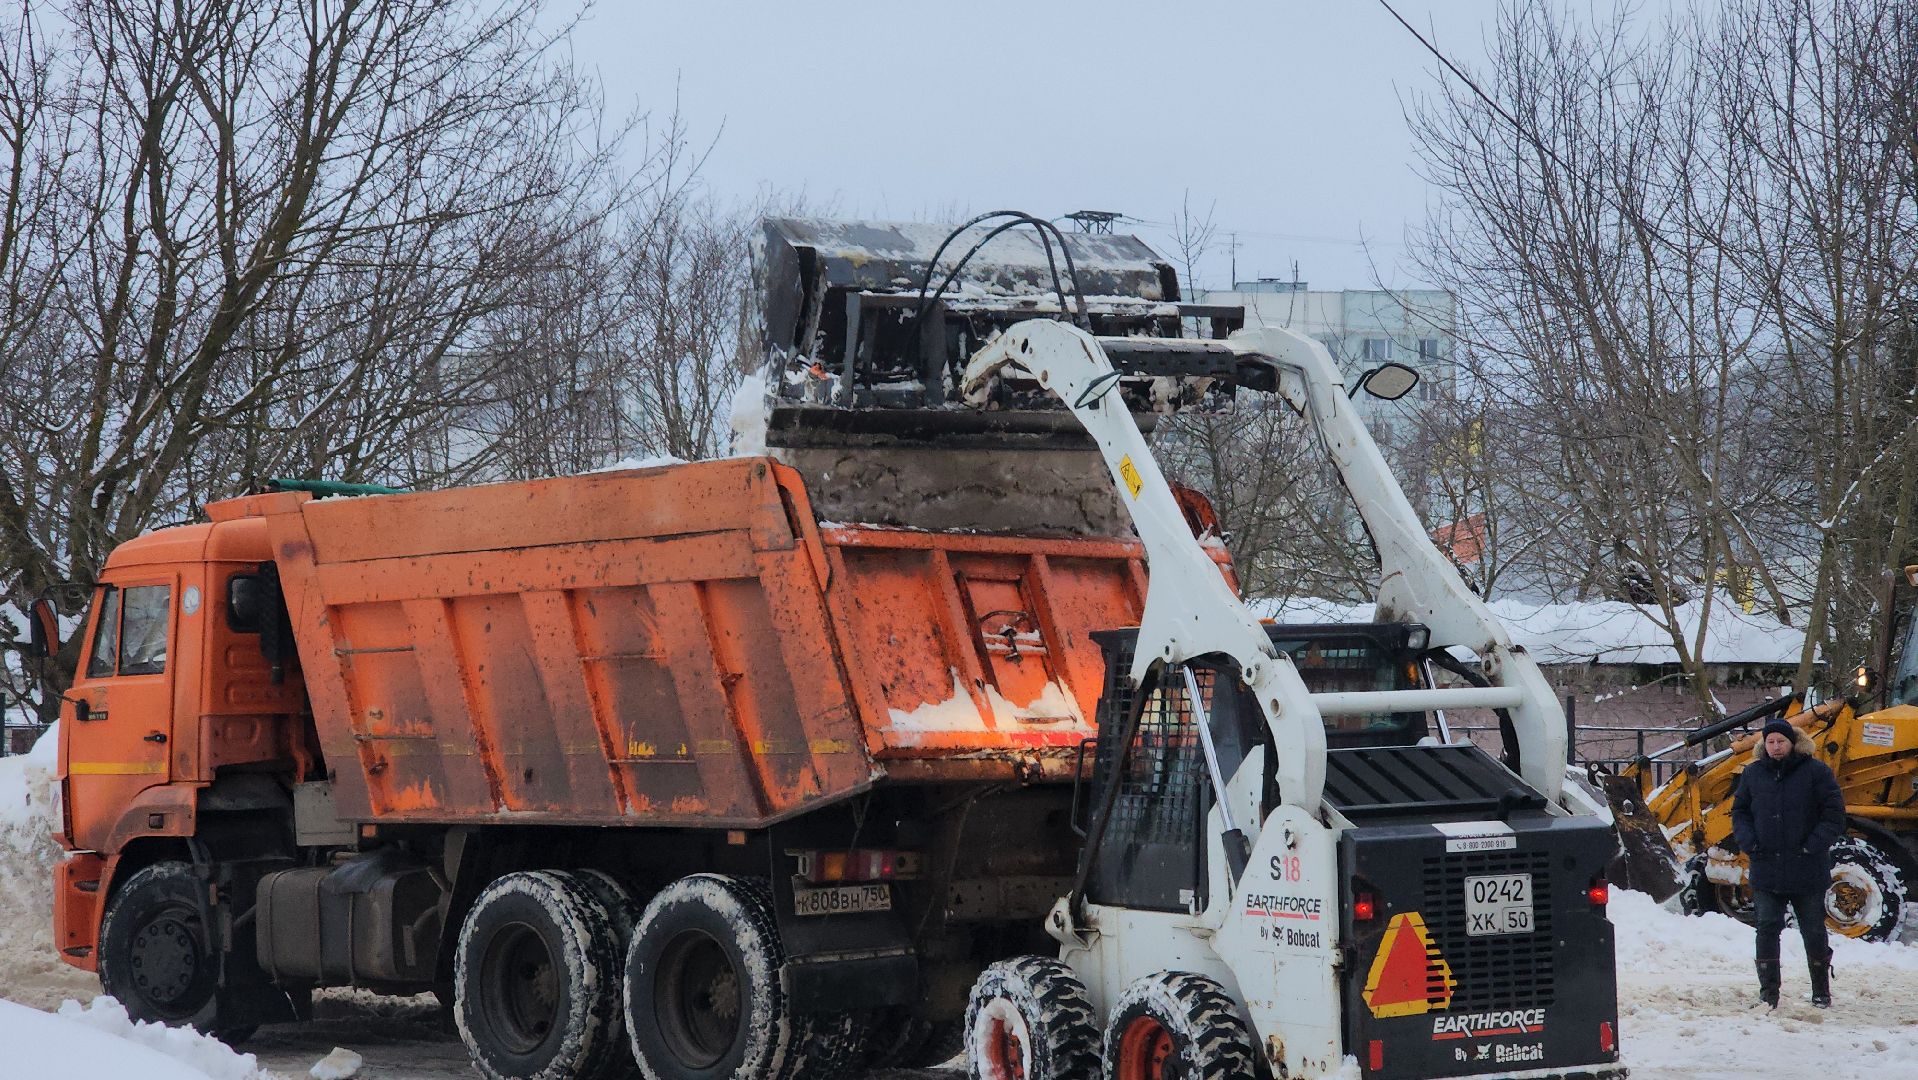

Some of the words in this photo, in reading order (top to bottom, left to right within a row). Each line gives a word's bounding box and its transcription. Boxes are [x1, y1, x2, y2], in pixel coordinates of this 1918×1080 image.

[1270, 855, 1301, 882] S18
[863, 887, 887, 902] 750
[1473, 879, 1524, 903] 0242
[1246, 894, 1322, 919] EARTHFORCE
[1472, 912, 1496, 931] ХК
[1508, 911, 1528, 928] 50
[1260, 926, 1269, 942] By
[1287, 929, 1321, 949] Bobcat
[1432, 1008, 1546, 1037] EARTHFORCE
[1454, 1047, 1467, 1061] By
[1495, 1042, 1544, 1063] Bobcat
